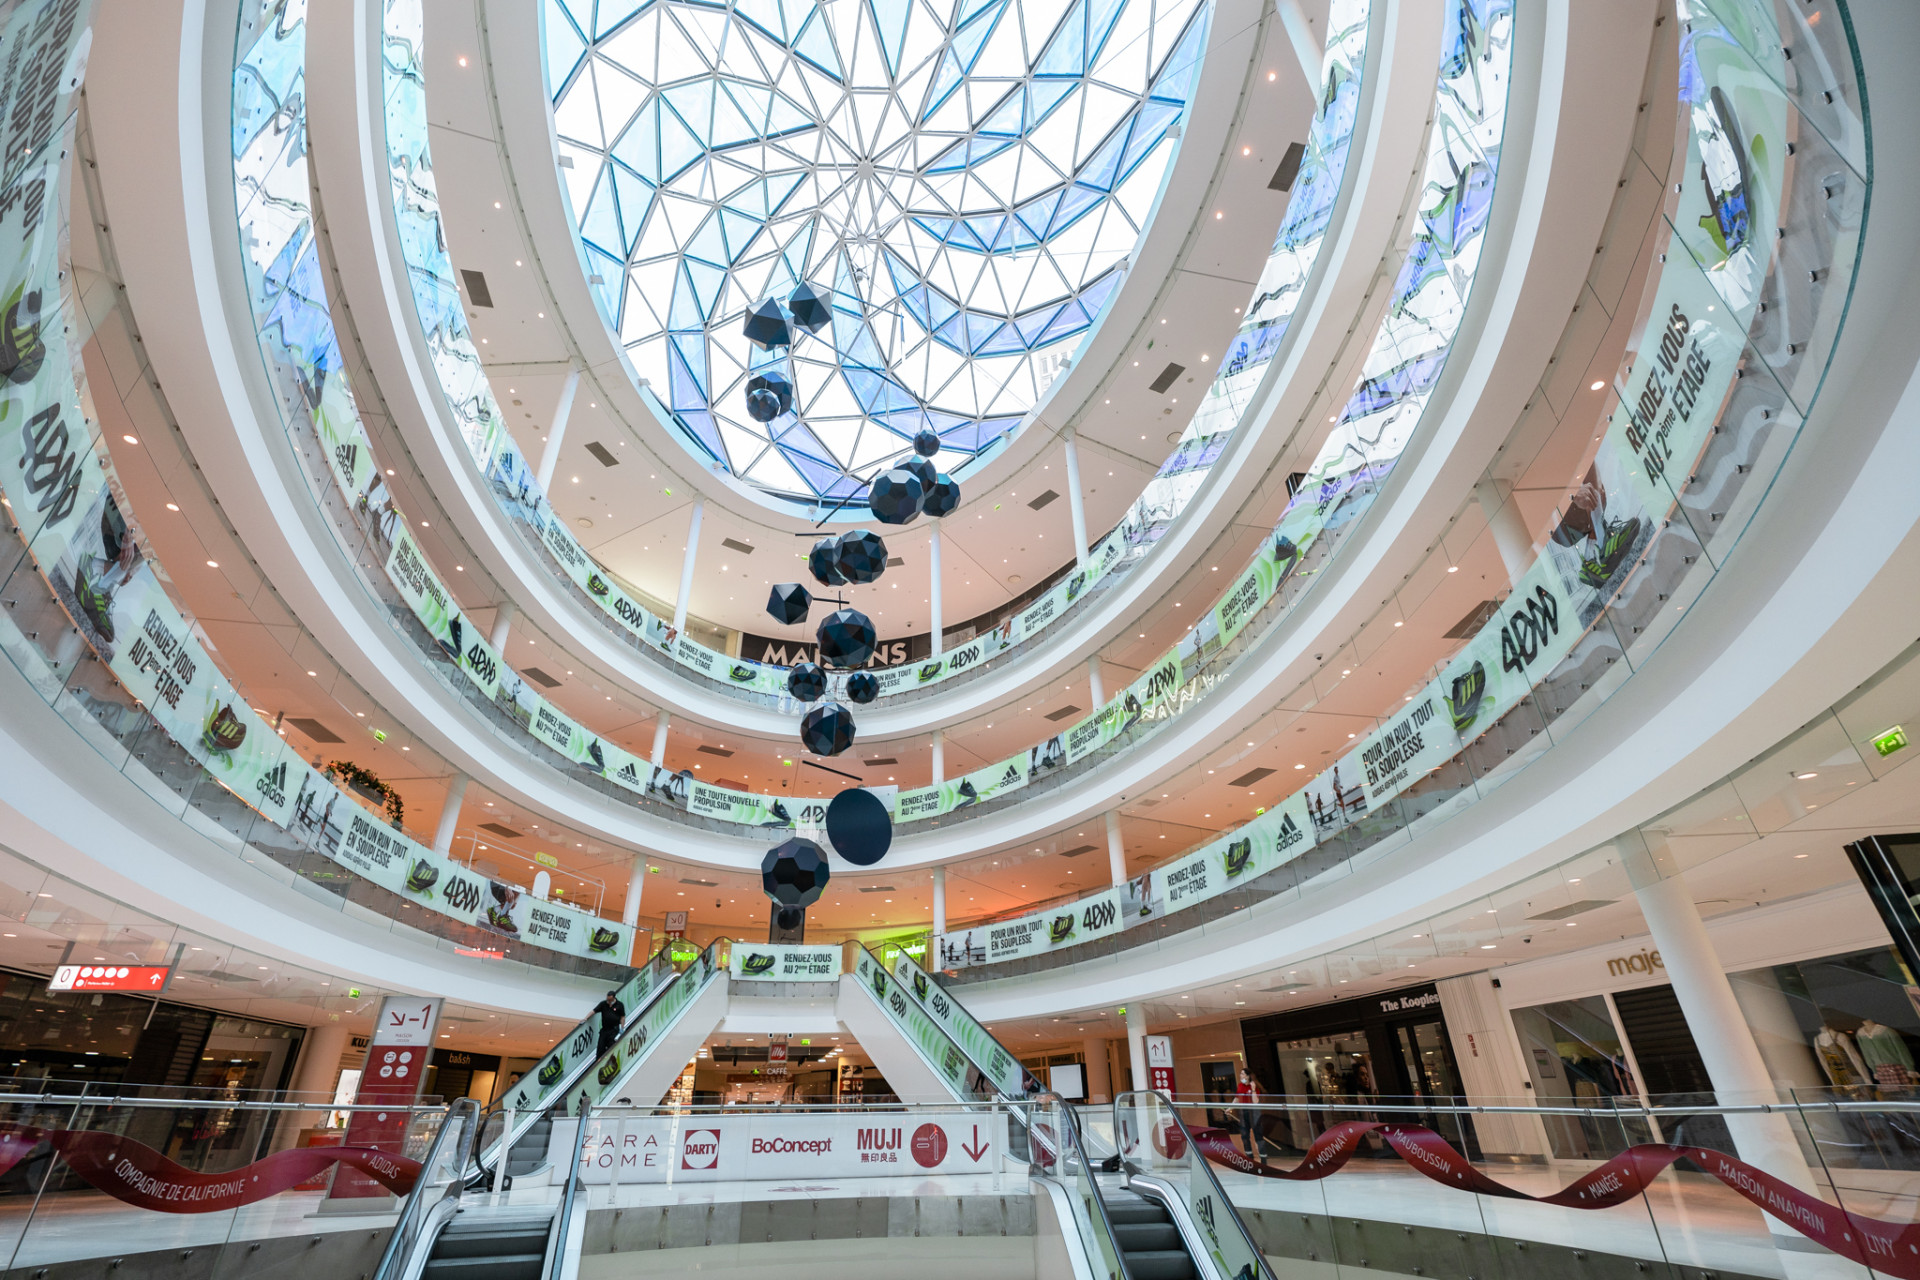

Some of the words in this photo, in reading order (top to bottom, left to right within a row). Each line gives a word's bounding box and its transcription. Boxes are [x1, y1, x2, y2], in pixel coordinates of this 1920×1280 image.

[1625, 303, 1690, 455] RENDEZ-VOUS
[1642, 442, 1665, 487] AU
[1669, 338, 1711, 424] ÉTAGE
[335, 446, 354, 488] adidas
[423, 573, 447, 611] NOUVELLE
[1221, 574, 1257, 619] RENDEZ-VOUS
[143, 608, 196, 685] RENDEZ-VOUS
[680, 640, 713, 663] RENDEZ-VOUS
[762, 642, 907, 669] MAINS
[128, 637, 148, 666] AU
[154, 664, 184, 711] ÉTAGE
[879, 679, 901, 689] PLESSE
[539, 707, 571, 736] RENDEZ-VOUS
[1069, 728, 1080, 741] UNE
[1079, 719, 1095, 737] TOUTE
[1070, 726, 1099, 751] PROPULSION
[1361, 742, 1384, 770] POUR
[1393, 718, 1412, 745] RUN
[1411, 699, 1435, 729] TOUT
[1366, 766, 1379, 786] EN
[1378, 732, 1425, 778] SOUPLESSE
[617, 770, 639, 786] adidas
[1000, 774, 1021, 788] adidas
[257, 778, 286, 808] adidas
[693, 797, 731, 811] PROPULSION
[695, 786, 707, 796] UNE
[707, 789, 727, 803] TOUTE
[727, 795, 760, 808] NOUVELLE
[901, 791, 940, 807] RENDEZ-VOUS
[352, 815, 369, 837] POUR
[377, 831, 391, 851] RUN
[391, 840, 408, 860] TOUT
[1276, 830, 1303, 852] adidas
[346, 831, 357, 849] EN
[356, 837, 392, 869] SOUPLESSE
[1167, 859, 1206, 887] RENDEZ-VOUS
[1170, 888, 1178, 902] AU
[531, 908, 572, 930] RENDEZ-VOUS
[991, 928, 1006, 940] POUR
[1007, 926, 1015, 937] UN
[1015, 924, 1028, 935] RUN
[1028, 920, 1043, 932] TOUT
[528, 922, 538, 936] AU
[548, 926, 568, 943] ÉTAGE
[991, 941, 999, 951] EN
[1000, 933, 1032, 949] SOUPLESSE
[783, 953, 832, 963] RENDEZ-VOUS
[783, 965, 793, 974] AU
[808, 963, 830, 974] ÉTAGE
[1607, 948, 1664, 977] maje
[60, 968, 71, 983] 0
[1380, 999, 1400, 1013] The
[1400, 993, 1440, 1011] Kooples
[409, 1004, 431, 1030] -1
[449, 1053, 471, 1065] ba&sh
[771, 1047, 786, 1058] illy
[767, 1066, 788, 1076] CAFFÉ
[582, 1134, 658, 1149] ZARA
[685, 1143, 717, 1155] DARTY
[751, 1137, 833, 1156] BoConcept
[857, 1128, 902, 1150] MUJI
[1317, 1134, 1349, 1167] MOOVWAY
[861, 1152, 898, 1163] 無印良品
[1209, 1137, 1254, 1172] WATERDROP
[1394, 1128, 1451, 1174] MAUBOUSSIN
[368, 1155, 401, 1179] ADIDAS
[114, 1158, 169, 1198] COMPAGNIE
[167, 1184, 182, 1200] DE
[182, 1179, 245, 1201] CALIFORNIE
[1588, 1171, 1623, 1199] MANÈGE
[1719, 1160, 1766, 1200] MAISON
[1768, 1189, 1827, 1234] ANAVRIN
